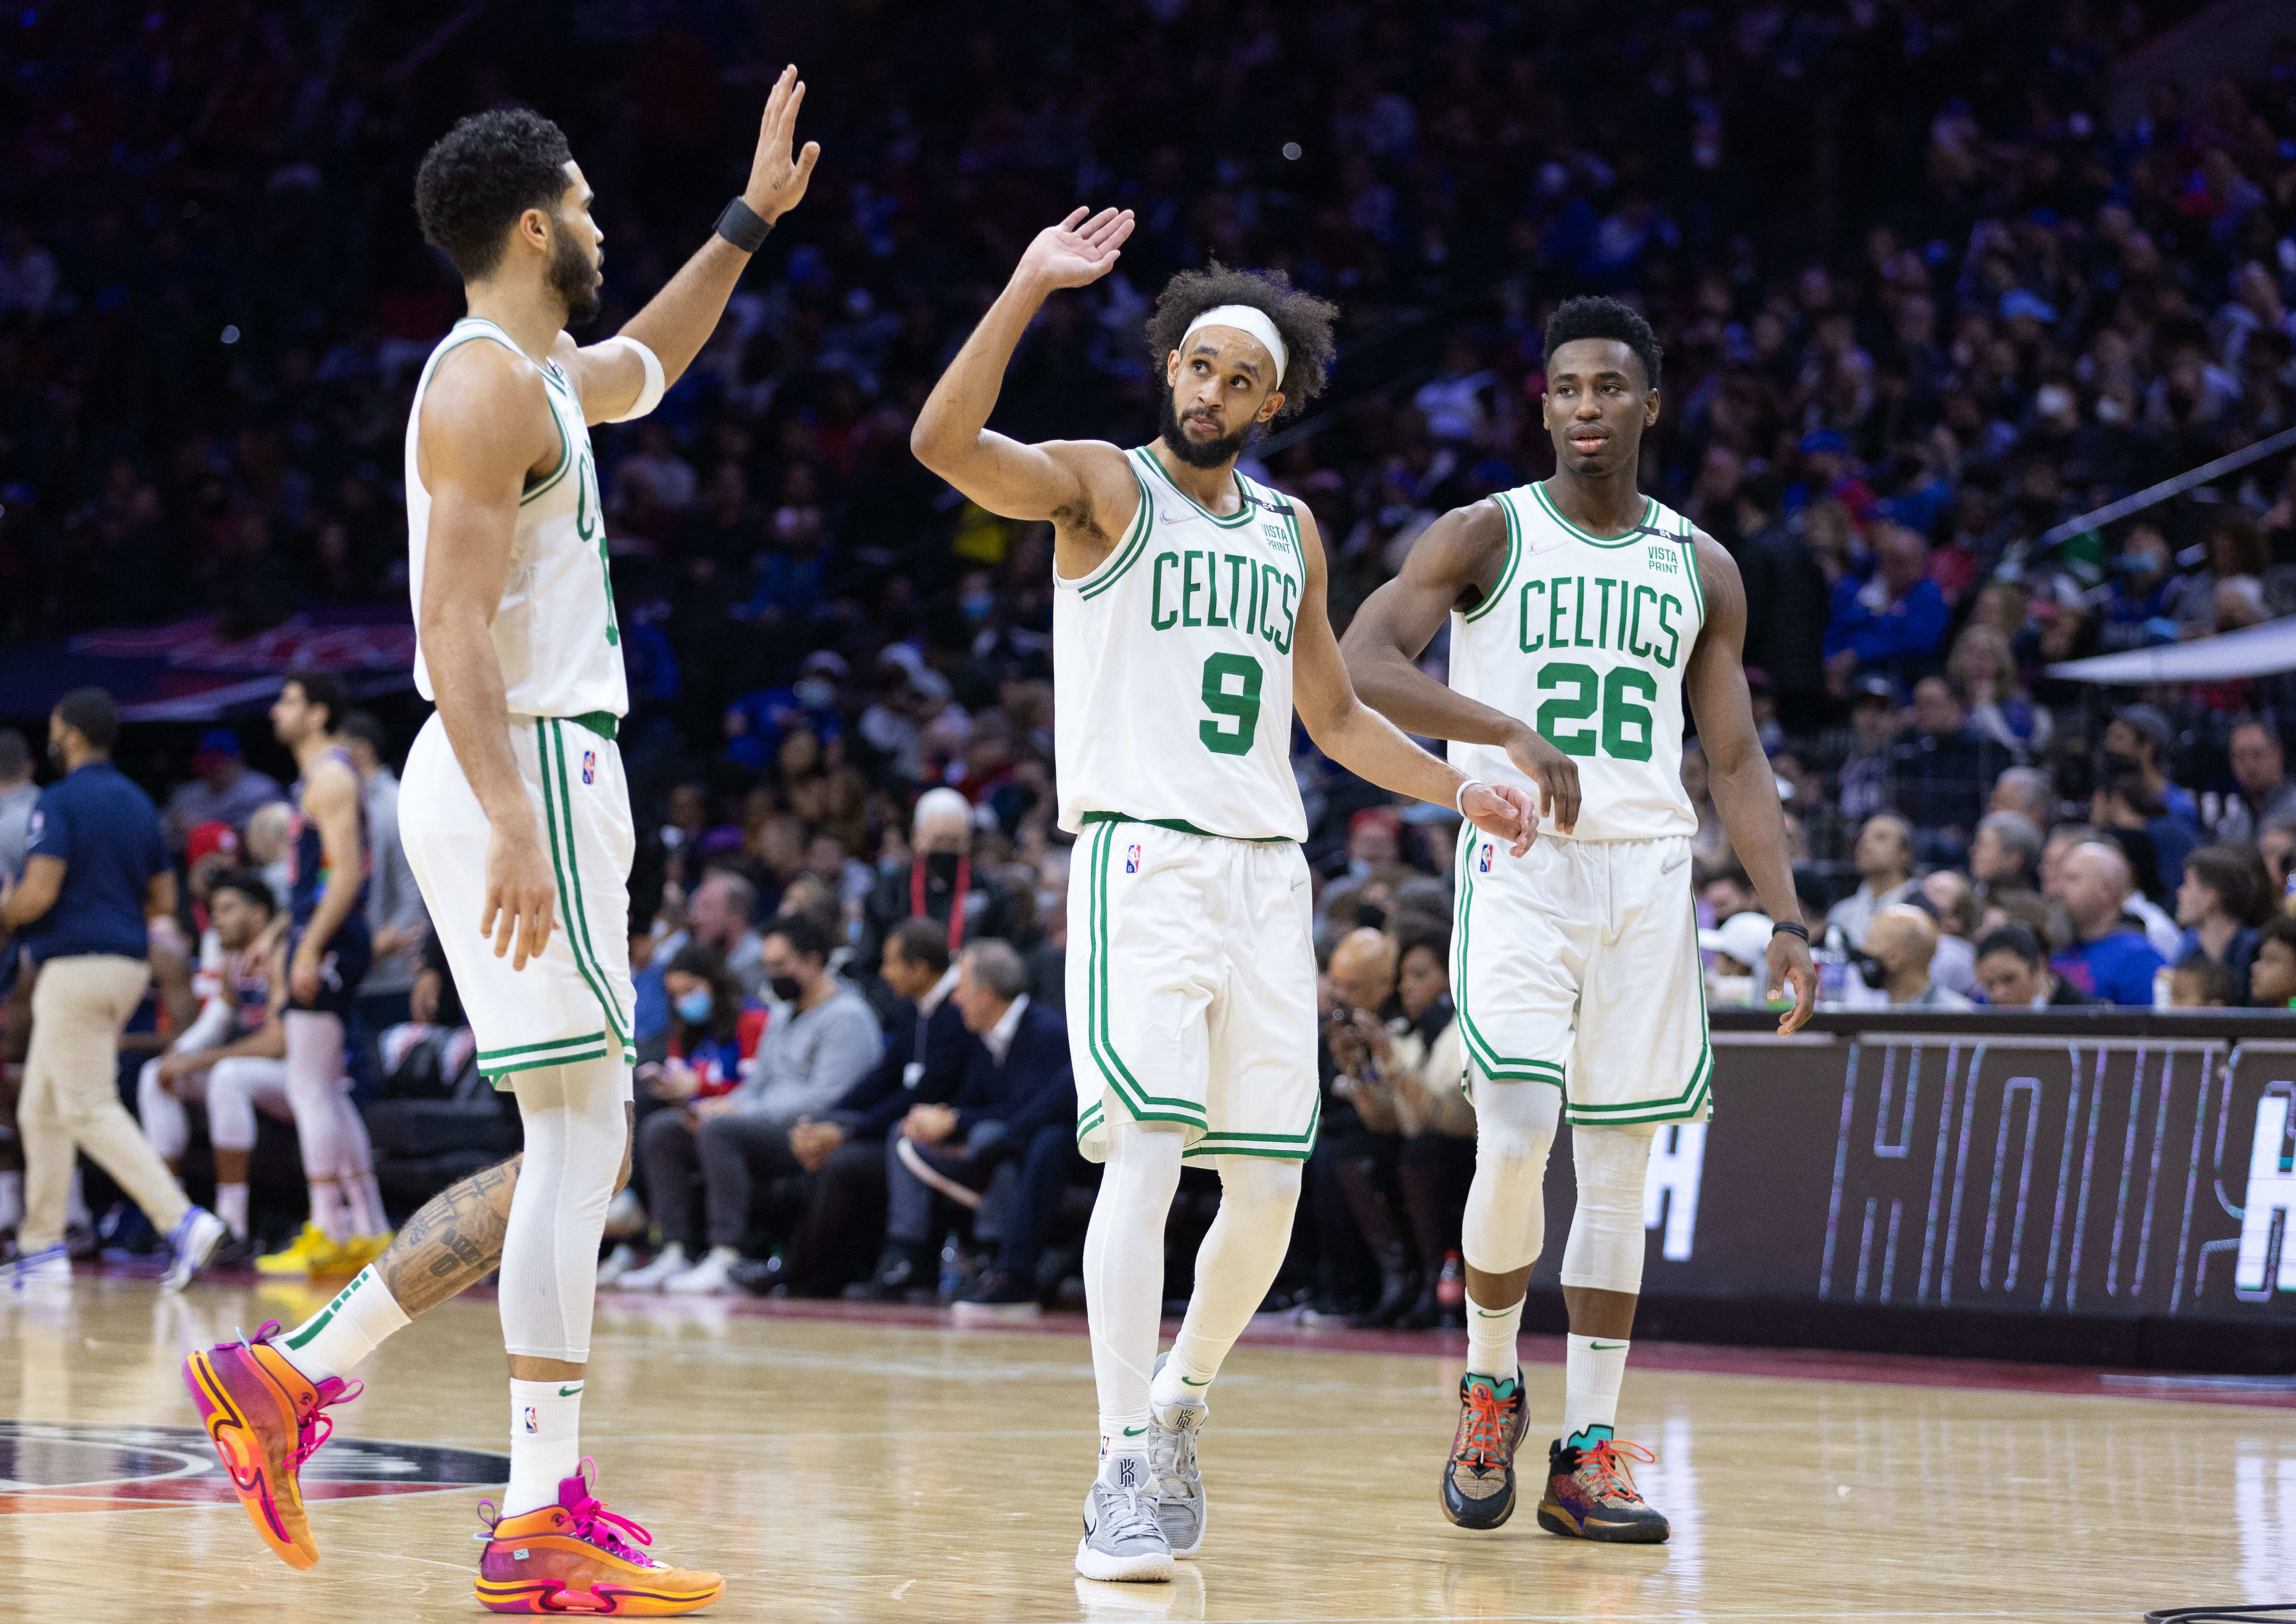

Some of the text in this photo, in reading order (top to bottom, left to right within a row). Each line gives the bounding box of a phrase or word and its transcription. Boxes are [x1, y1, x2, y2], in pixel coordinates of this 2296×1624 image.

[1261, 524, 1289, 543] VISTA
[1266, 538, 1290, 554] PRINT
[1649, 546, 1678, 565] VISTA
[1649, 560, 1678, 575] PRINT
[1151, 550, 1297, 656] CELTICS
[1519, 576, 1682, 668] CELTICS
[1200, 652, 1263, 756] 9
[1537, 662, 1657, 762] 26
